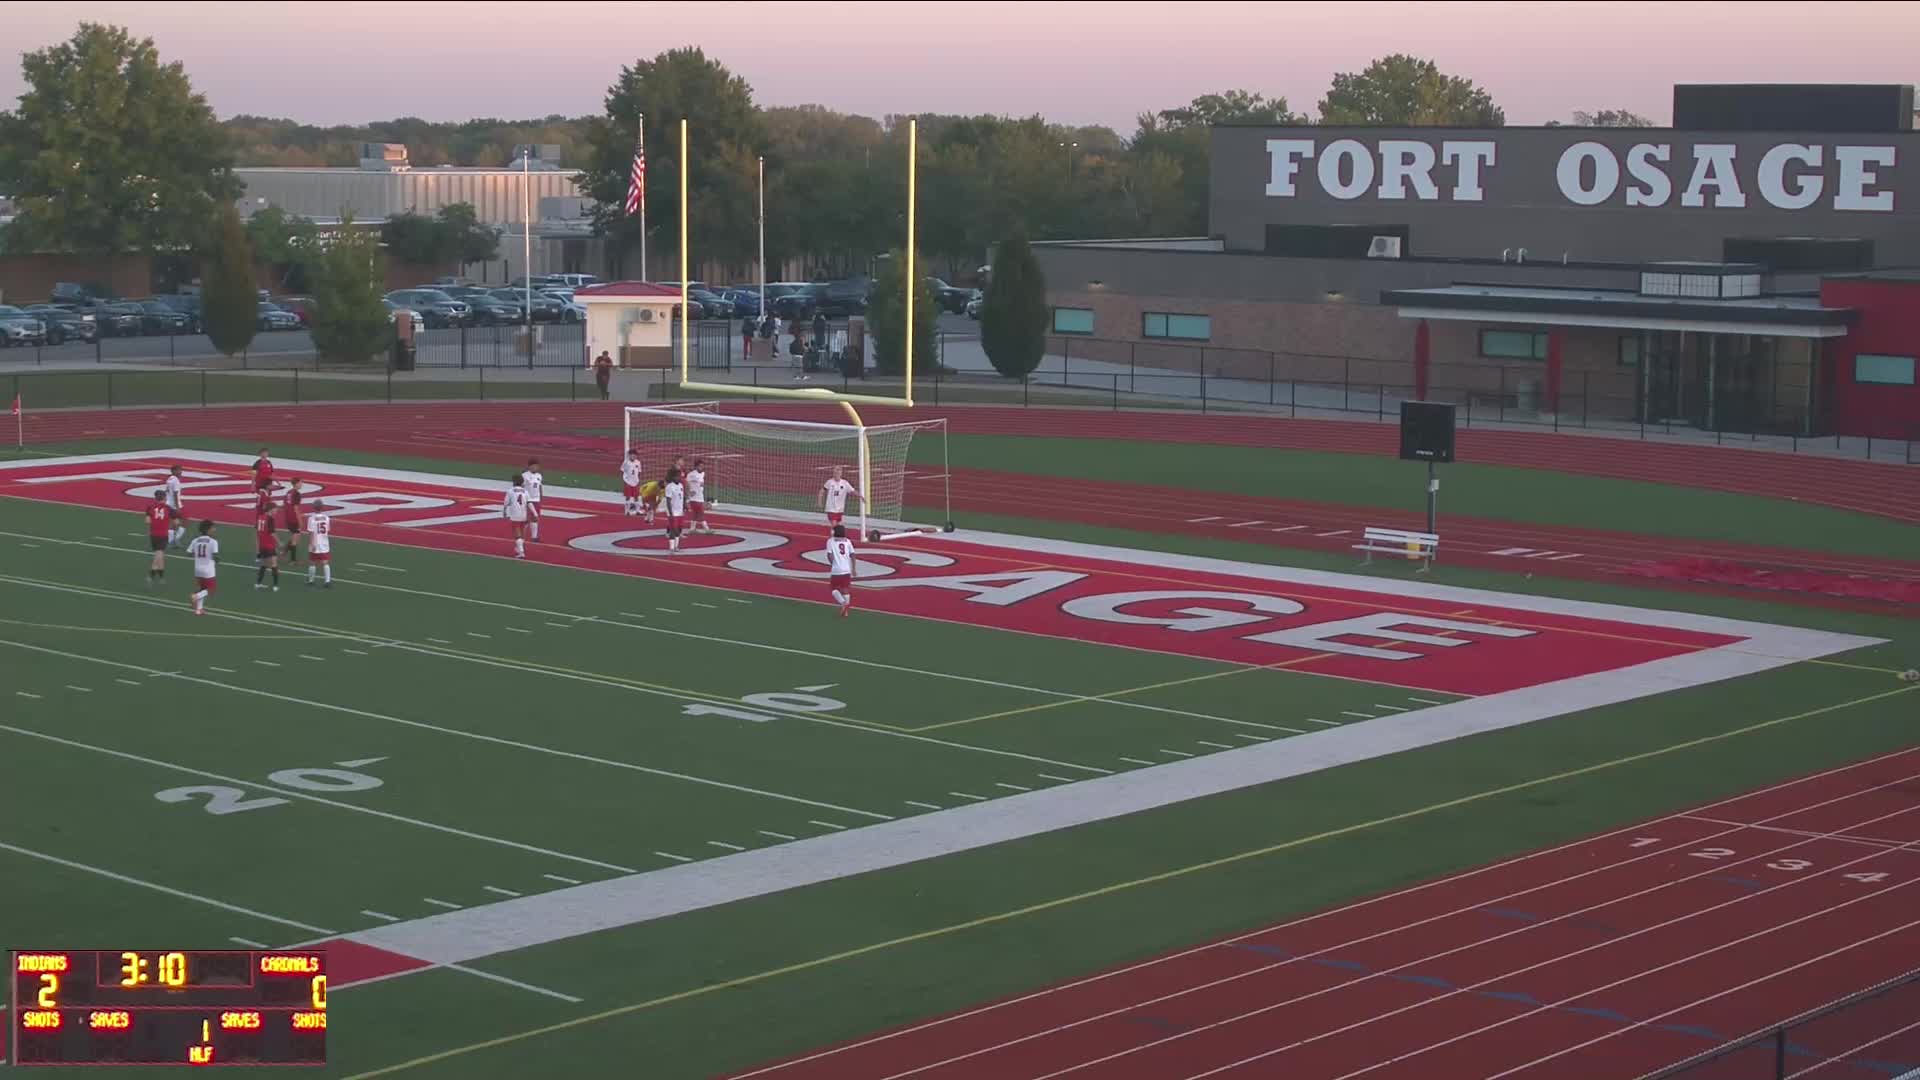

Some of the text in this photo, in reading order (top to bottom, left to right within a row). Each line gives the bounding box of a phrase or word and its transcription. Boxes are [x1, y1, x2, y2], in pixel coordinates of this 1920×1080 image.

[1265, 138, 1896, 212] FORT OSAGE
[517, 494, 523, 505] 4
[154, 506, 165, 520] 14
[316, 521, 327, 534] 15
[838, 542, 846, 555] 9
[566, 528, 1537, 661] OSAGE
[681, 692, 846, 723] 10
[154, 767, 384, 815] 20
[1628, 837, 1662, 848] 1
[1687, 847, 1737, 860] 2
[1766, 859, 1814, 871] 3
[1842, 872, 1891, 883] 4
